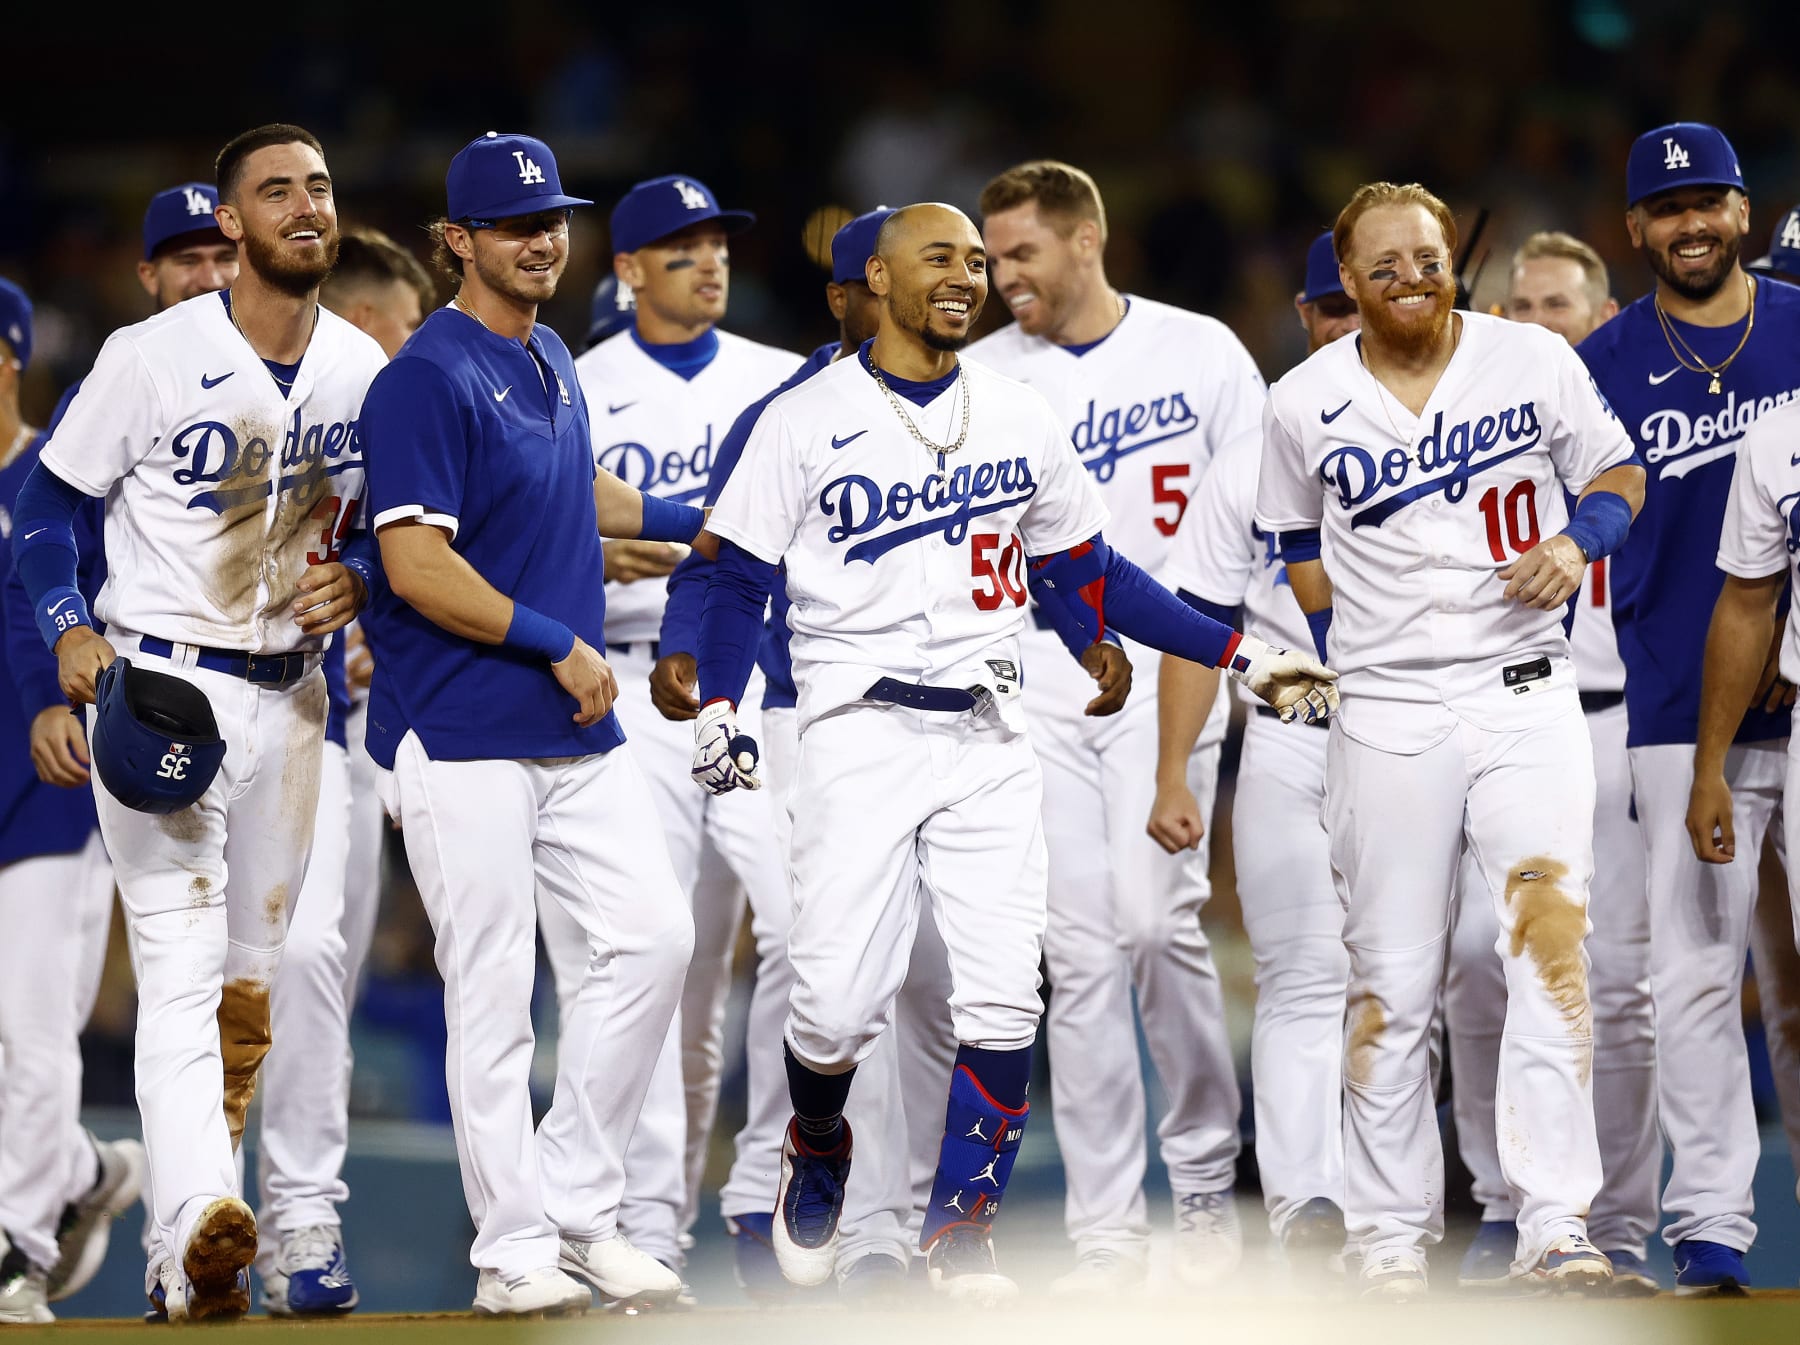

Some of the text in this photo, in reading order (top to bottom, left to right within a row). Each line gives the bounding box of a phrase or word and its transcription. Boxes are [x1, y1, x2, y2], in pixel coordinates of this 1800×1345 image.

[512, 151, 545, 184] LA
[1663, 138, 1690, 169] LA
[182, 187, 213, 215] LA
[673, 181, 709, 209] LA
[1320, 402, 1541, 510] Dodgers
[820, 450, 1037, 546] Dodgers
[1152, 464, 1190, 537] 5
[1479, 479, 1540, 563] 10
[971, 533, 1027, 611] 50
[55, 610, 79, 632] 35
